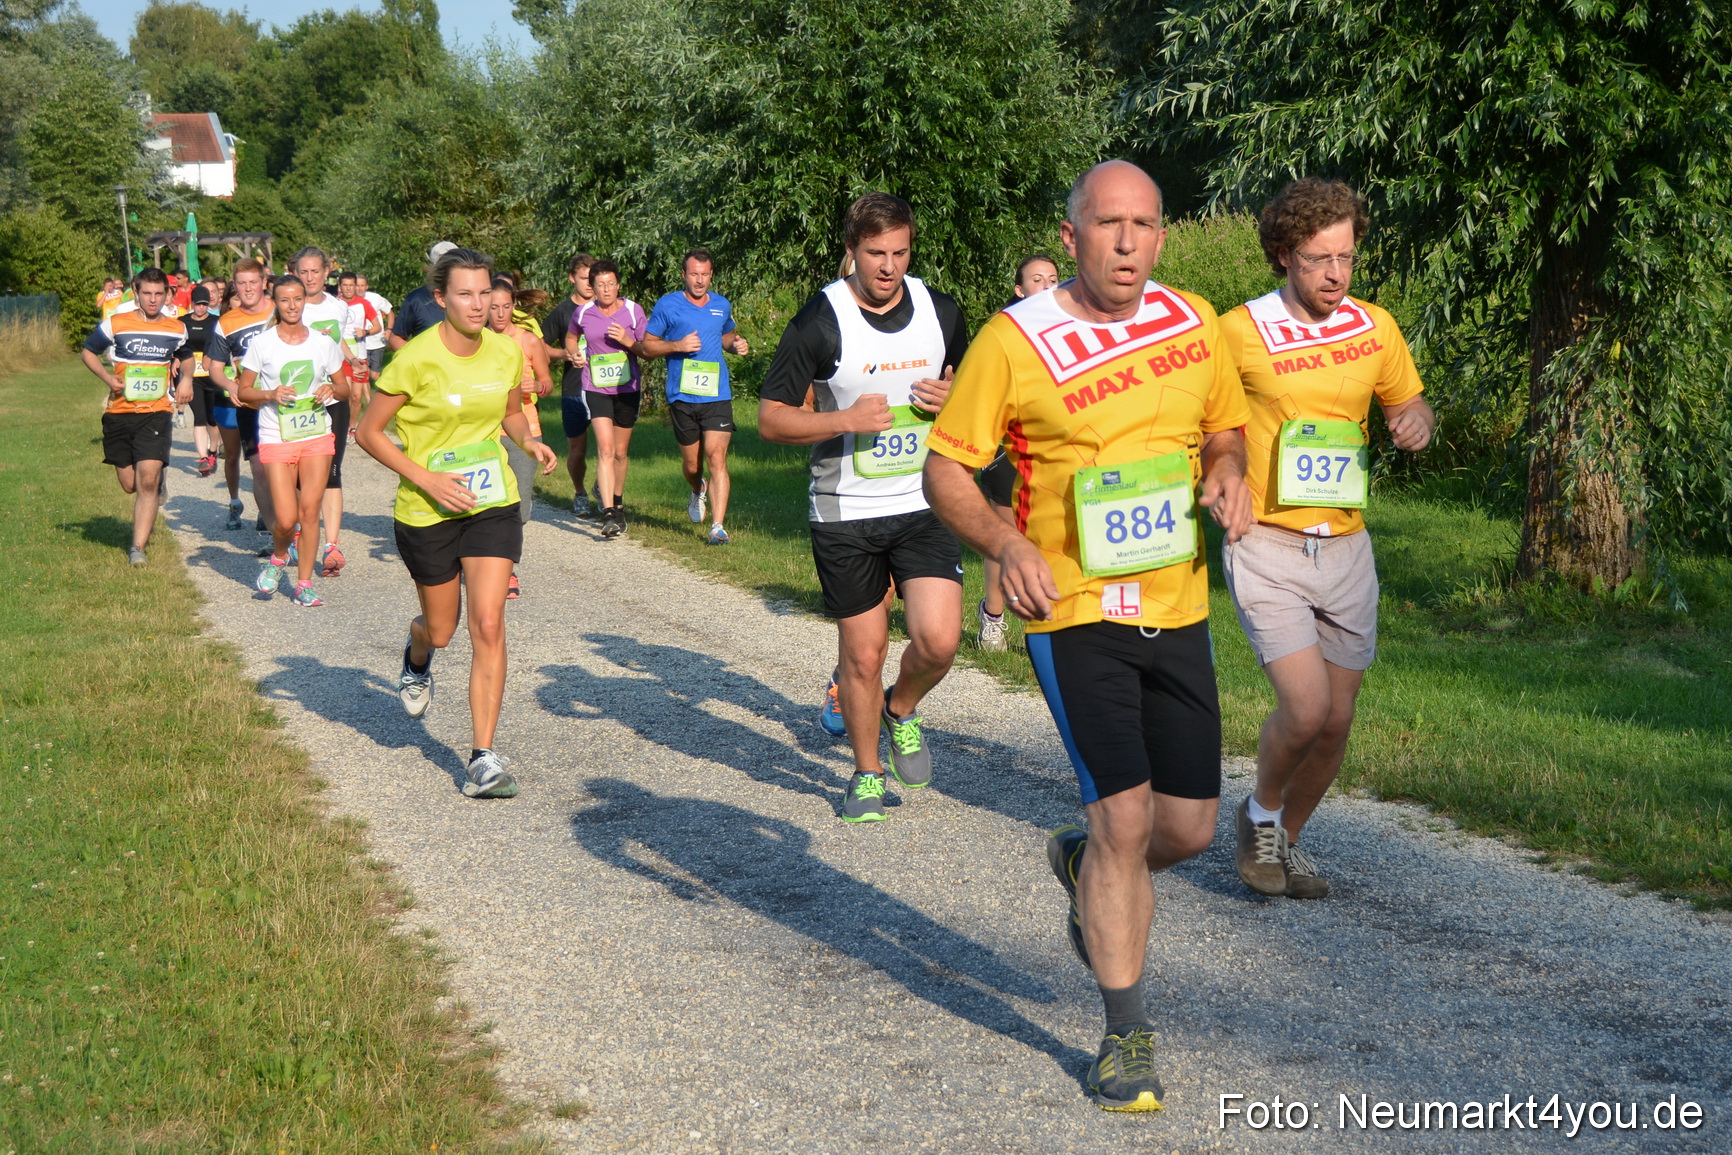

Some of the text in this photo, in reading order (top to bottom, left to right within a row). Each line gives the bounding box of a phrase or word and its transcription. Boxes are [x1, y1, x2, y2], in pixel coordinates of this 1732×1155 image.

[133, 341, 170, 354] Fischer
[1271, 338, 1384, 376] MAX BÖGL
[599, 366, 623, 378] 302
[880, 359, 932, 371] KLEBL
[694, 374, 709, 387] 12
[1062, 338, 1211, 415] MAX BÖGL
[133, 380, 158, 392] 455
[290, 413, 317, 429] 124
[872, 432, 918, 458] 593
[1296, 454, 1351, 483] 937
[1317, 487, 1339, 495] Schulze
[1105, 499, 1176, 544] 884
[1116, 550, 1140, 558] Martin
[1140, 543, 1171, 555] Gerhardt
